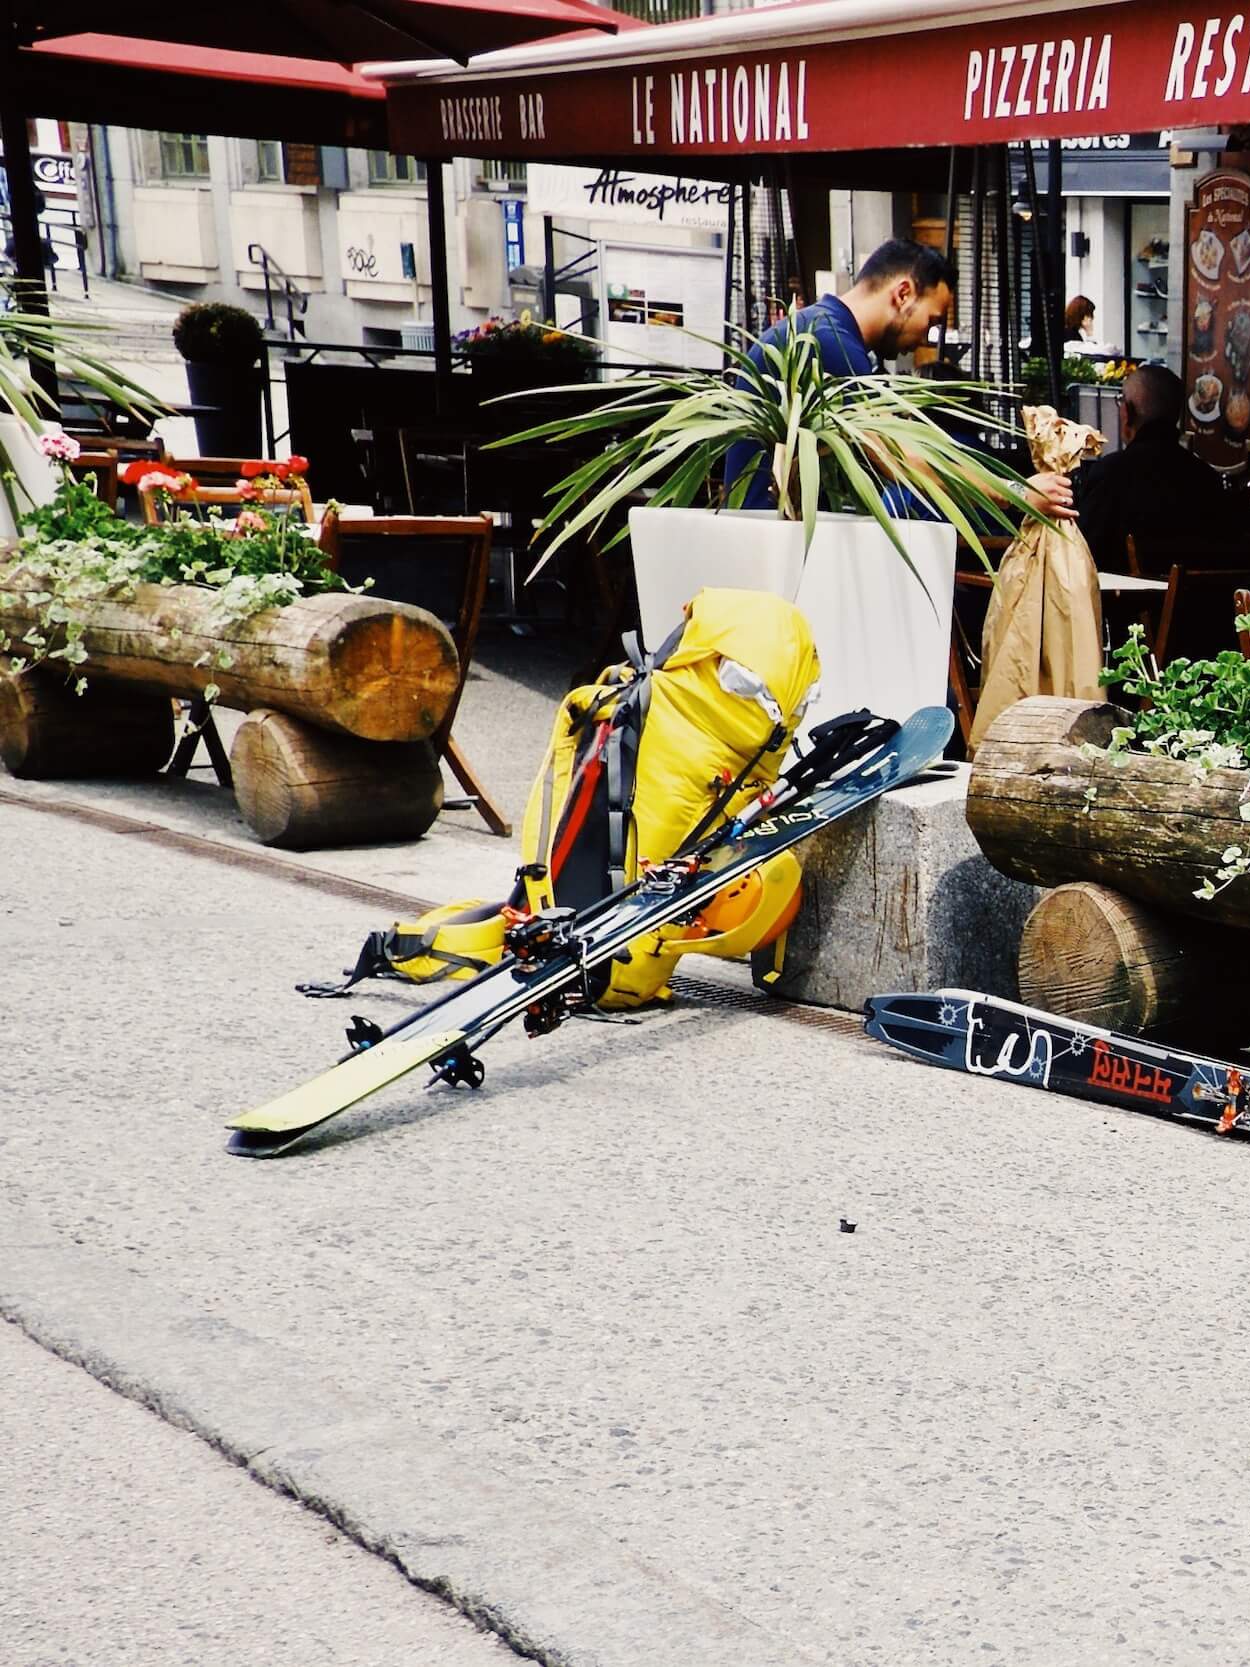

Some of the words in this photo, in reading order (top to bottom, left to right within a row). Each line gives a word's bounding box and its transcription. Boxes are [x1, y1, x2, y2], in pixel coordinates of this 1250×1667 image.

[440, 96, 502, 141] BRASSERIE
[519, 93, 546, 140] BAR
[632, 76, 656, 145] LE
[670, 60, 809, 145] NATIONAL
[964, 34, 1113, 120] PIZZERIA
